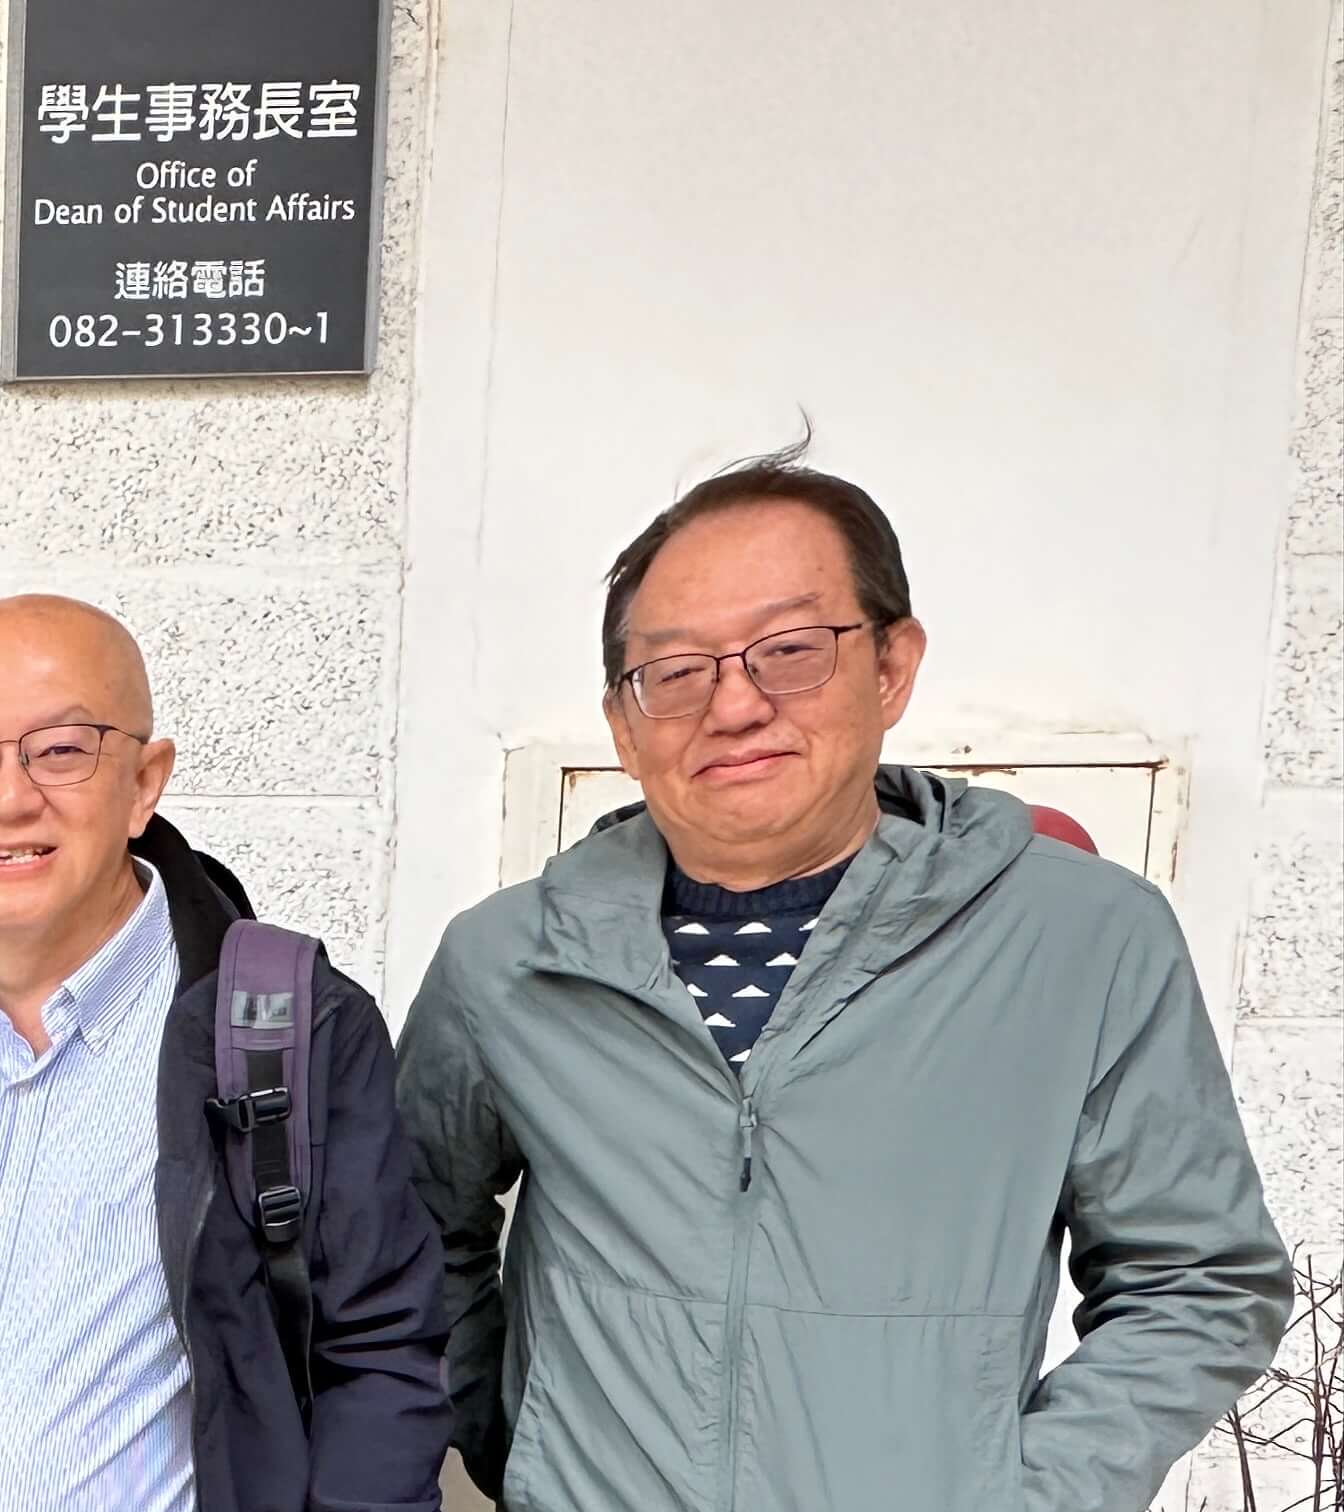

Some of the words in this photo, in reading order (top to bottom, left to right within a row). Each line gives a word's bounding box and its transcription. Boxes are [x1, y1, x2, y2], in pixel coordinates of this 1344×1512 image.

[37, 79, 361, 144] 學生事務長室
[136, 161, 217, 190] Office
[227, 159, 258, 188] of
[34, 198, 103, 225] Dean
[114, 196, 144, 224] of
[151, 194, 258, 224] Student
[265, 192, 355, 222] Affairs
[114, 259, 265, 300] 連絡電話
[49, 312, 328, 348] 082-313330~1
